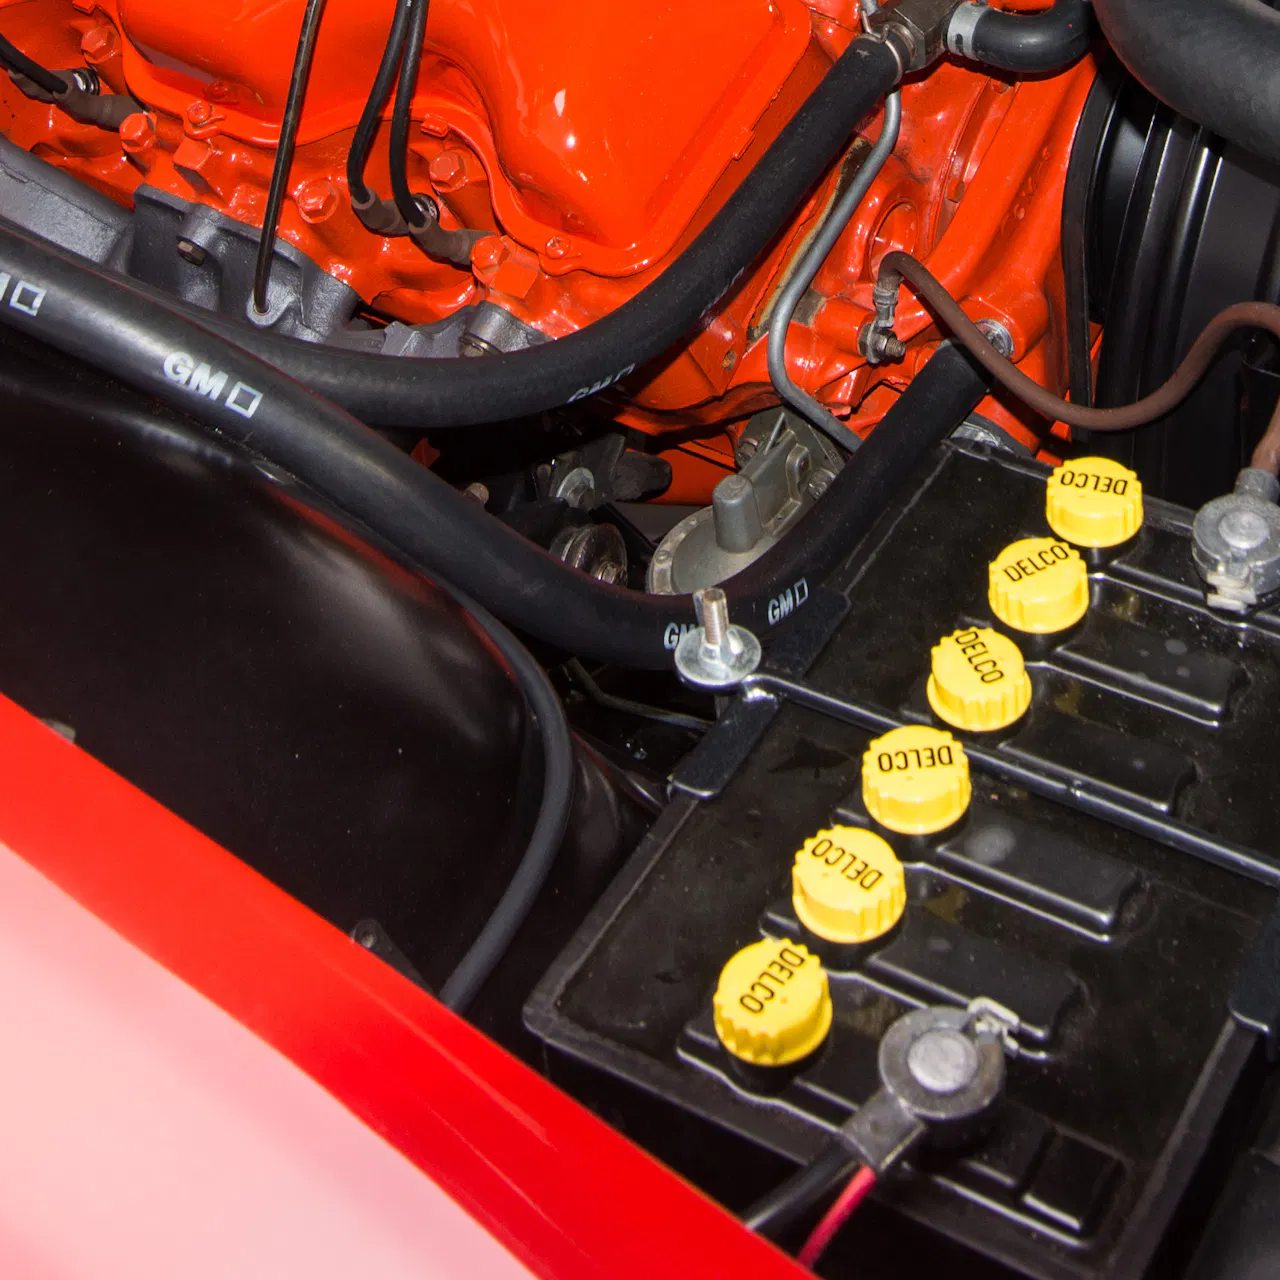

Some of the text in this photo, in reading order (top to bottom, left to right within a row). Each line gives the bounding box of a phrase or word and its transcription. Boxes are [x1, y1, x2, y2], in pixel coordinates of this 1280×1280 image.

[163, 351, 228, 401] GM
[1060, 470, 1128, 496] DELCO
[1003, 545, 1070, 582] DELCO
[768, 588, 794, 625] GM
[955, 631, 1004, 684] DELCO
[877, 745, 954, 772] DELCO
[811, 838, 883, 890] DELCO
[740, 948, 806, 1014] DELCO
